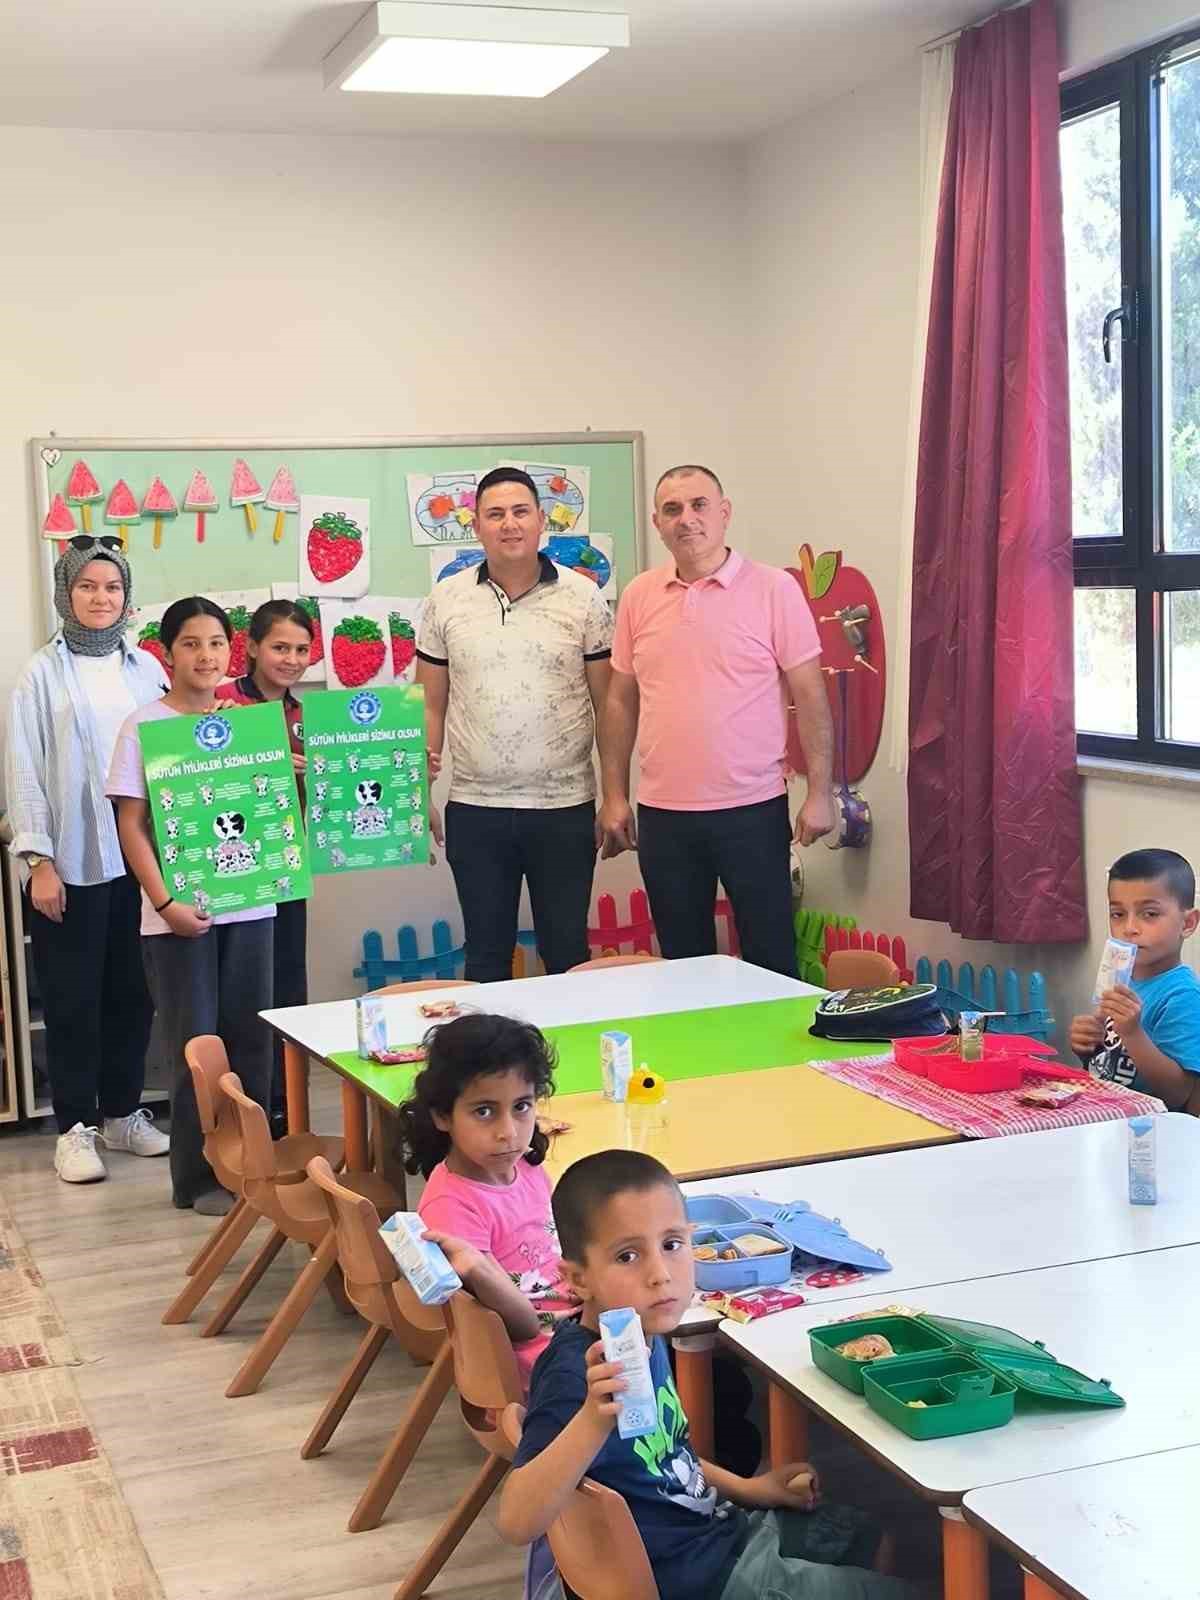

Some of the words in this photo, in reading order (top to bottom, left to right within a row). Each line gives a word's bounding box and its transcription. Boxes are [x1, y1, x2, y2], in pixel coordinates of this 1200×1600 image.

[308, 733, 335, 746] SÜTÜN
[397, 727, 421, 739] OLSUN
[256, 749, 285, 764] OLSUN
